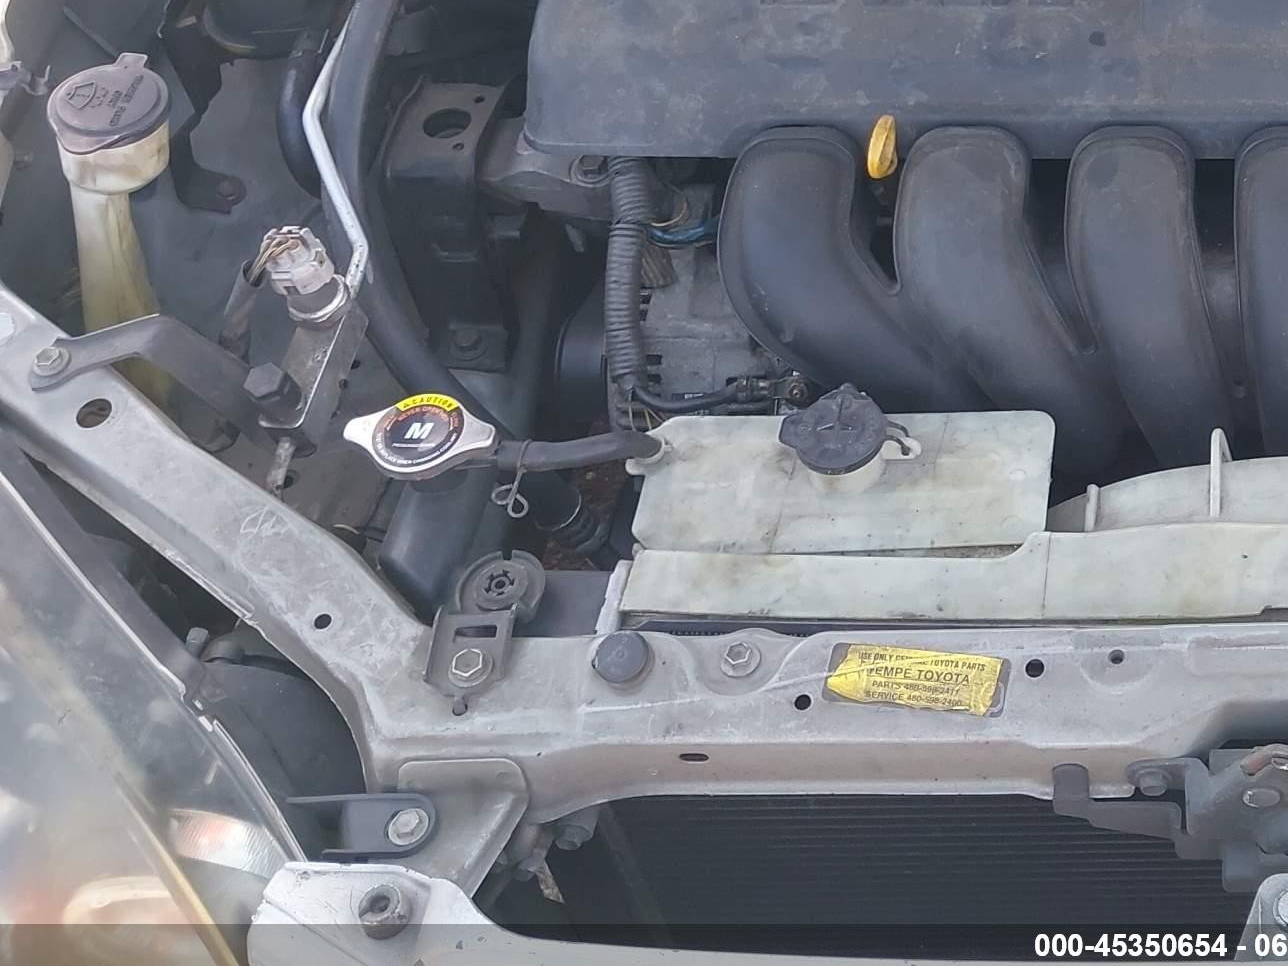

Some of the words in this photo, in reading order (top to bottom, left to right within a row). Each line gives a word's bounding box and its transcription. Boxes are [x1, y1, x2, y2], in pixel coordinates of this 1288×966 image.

[411, 396, 454, 408] CAUTION
[404, 422, 434, 439] M
[873, 652, 895, 662] ONLY
[930, 659, 959, 668] TOYOTA
[961, 661, 986, 671] PARTS
[916, 669, 970, 684] TOYOTA
[872, 680, 901, 690] PARTS
[864, 690, 905, 701] SERVICE
